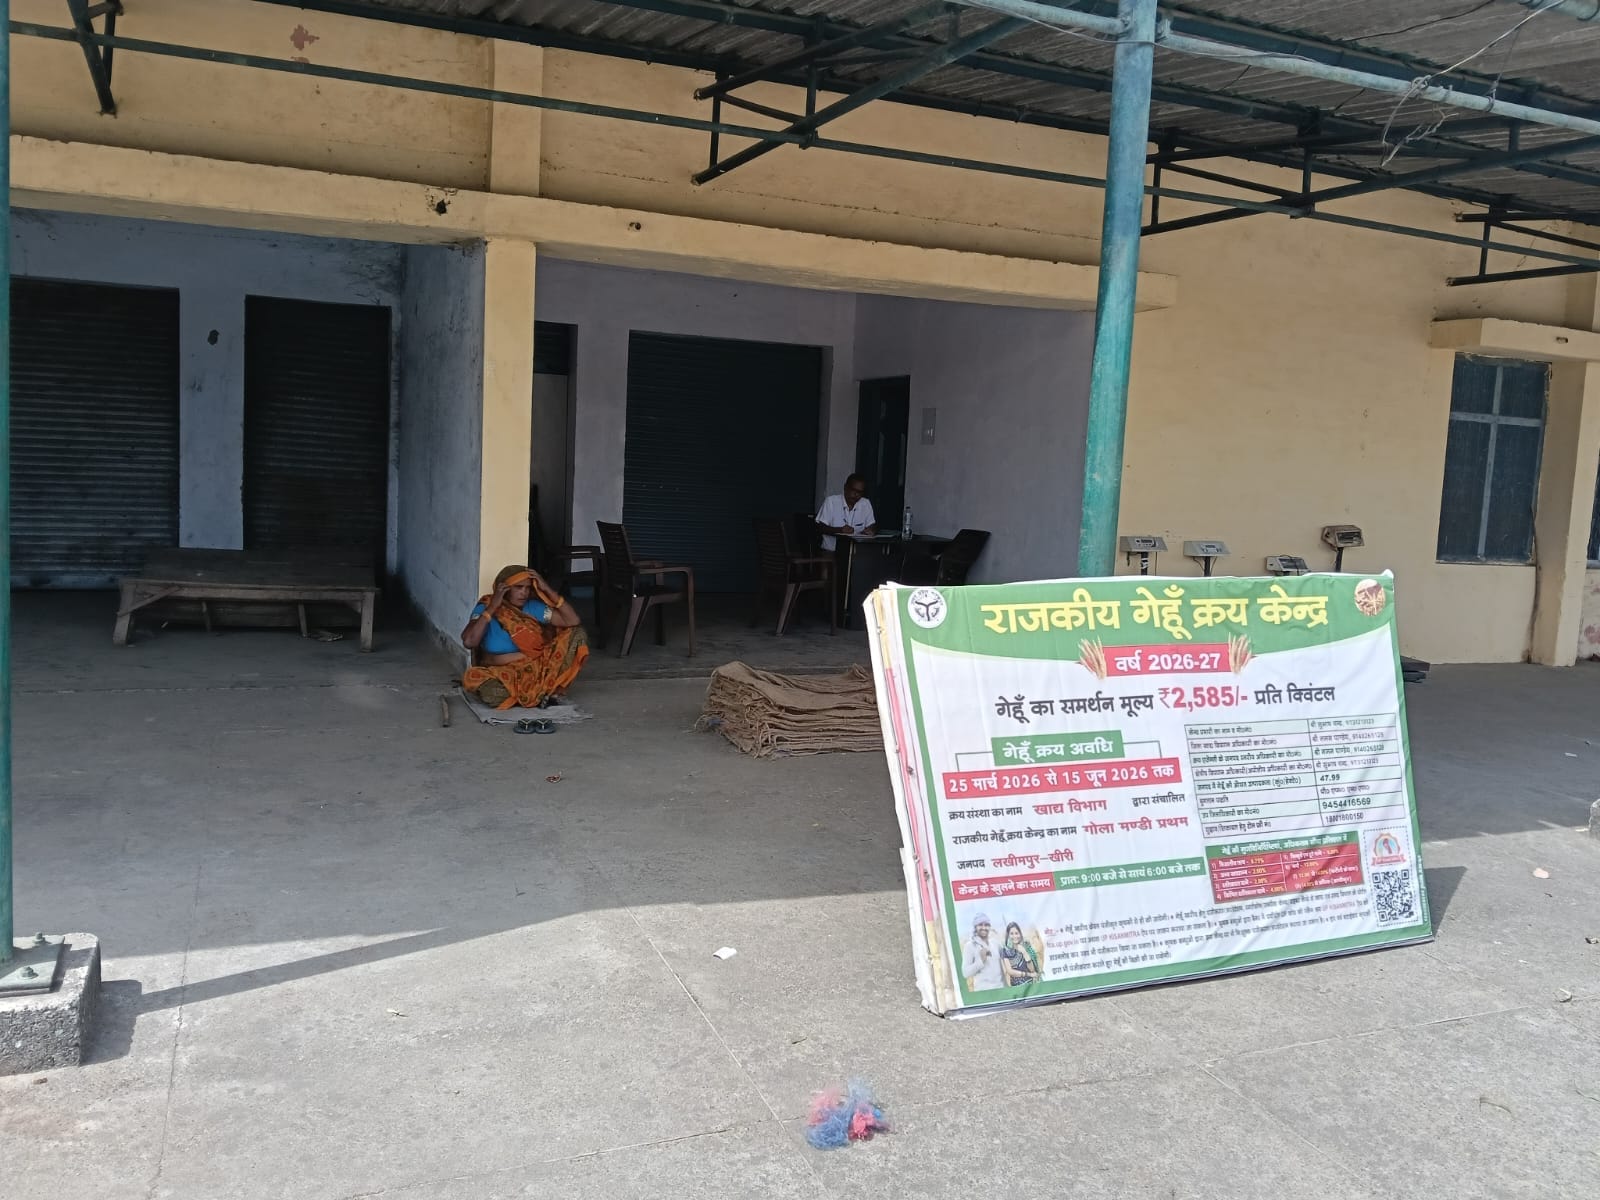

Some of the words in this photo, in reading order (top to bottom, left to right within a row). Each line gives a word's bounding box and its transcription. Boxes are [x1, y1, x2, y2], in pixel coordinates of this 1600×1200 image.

[980, 587, 1121, 634] राजकीय
[1130, 584, 1193, 640] गेहूँ
[1190, 597, 1249, 629] क्रय
[1256, 584, 1329, 629] केन्द्र
[1114, 649, 1140, 671] वर्ष
[1148, 653, 1219, 670] 2026-27
[995, 694, 1029, 723] गेहूँ
[1029, 700, 1054, 715] का
[1059, 690, 1113, 713] समर्थन
[1119, 694, 1153, 716] मूल्य
[1159, 686, 1247, 711] ₹2,585/-
[1254, 683, 1281, 704] प्रति
[1286, 682, 1334, 702] क्विंटल
[1002, 740, 1034, 767] गेहूँ
[1034, 743, 1064, 757] क्रय
[1070, 737, 1112, 754] अवधि
[949, 778, 967, 792] 25
[971, 772, 997, 790] मार्च
[1002, 774, 1040, 788] 2026
[1044, 768, 1057, 784] से
[1062, 771, 1080, 784] 15
[1085, 769, 1106, 790] जून
[1111, 766, 1147, 780] 2026
[1151, 764, 1173, 777] तक
[1319, 773, 1339, 781] 47.99
[948, 810, 964, 819] क्रय
[966, 809, 989, 818] संस्था
[991, 808, 1004, 816] का
[1005, 806, 1022, 815] नाम
[1032, 803, 1063, 814] खाद्य
[1067, 798, 1106, 812] विभाग
[1131, 796, 1149, 807] द्वारा
[1151, 791, 1184, 803] संचालित
[1322, 797, 1370, 808] 9454416569
[952, 831, 988, 844] राजकीय
[989, 829, 1010, 842] गेहूँ
[1009, 830, 1022, 839] क्रय
[1023, 826, 1044, 837] केन्द्र
[1046, 827, 1058, 836] का
[1059, 826, 1076, 834] नाम
[1082, 821, 1114, 834] गोला
[1118, 816, 1151, 831] मण्डी
[1156, 816, 1188, 827] प्रथम
[957, 859, 985, 869] जनपद
[1080, 872, 1100, 883] 9:00
[1101, 868, 1116, 880] बजे
[1117, 867, 1126, 878] से
[1146, 865, 1166, 876] 6:00
[1167, 862, 1181, 873] बजे
[1181, 862, 1200, 872] तक
[958, 885, 983, 895] केन्द्र
[982, 882, 993, 892] के
[1015, 880, 1028, 889] का
[1029, 878, 1050, 887] समय
